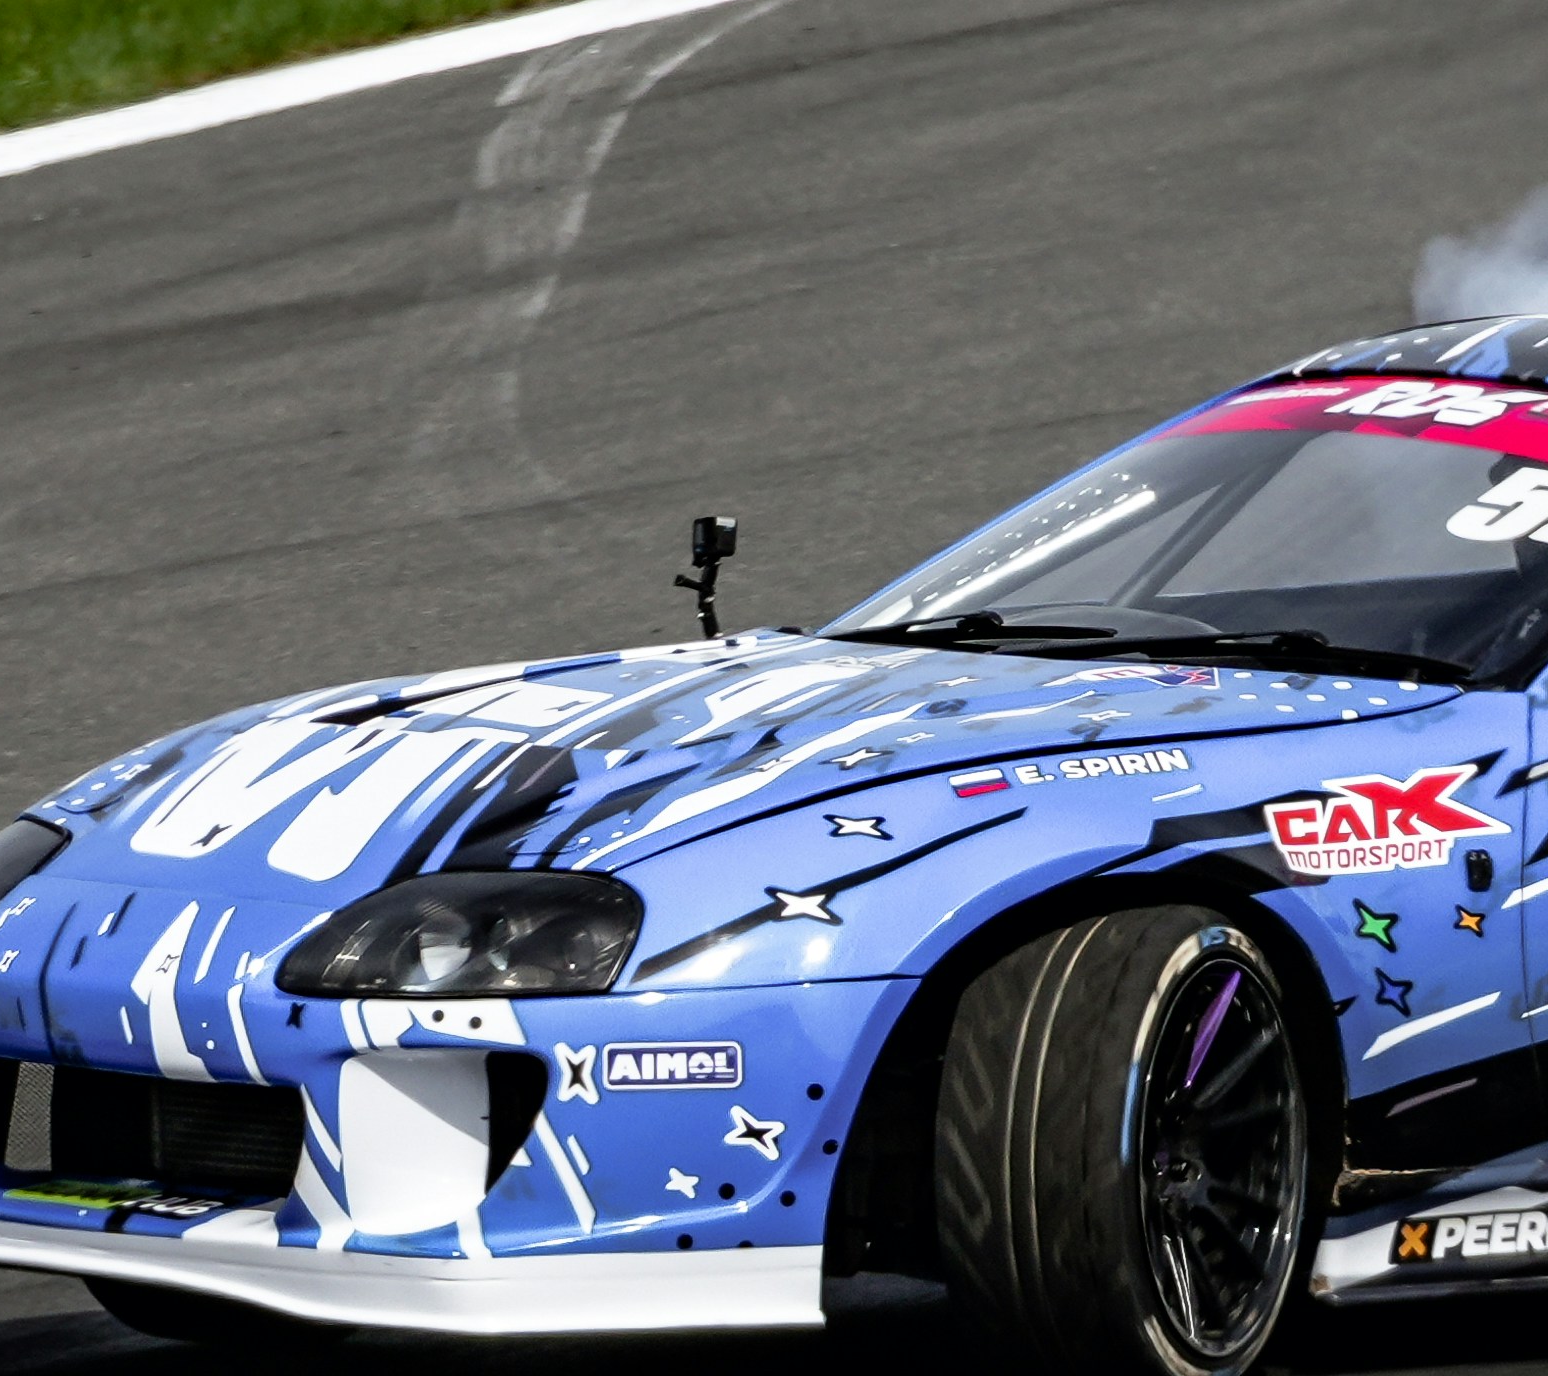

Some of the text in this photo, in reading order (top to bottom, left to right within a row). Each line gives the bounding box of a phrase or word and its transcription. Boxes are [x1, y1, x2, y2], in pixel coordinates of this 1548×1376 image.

[1014, 748, 1191, 785] E. SPIRIN
[1287, 838, 1447, 870] MOTORSPORT
[608, 1051, 736, 1080] AIMOL
